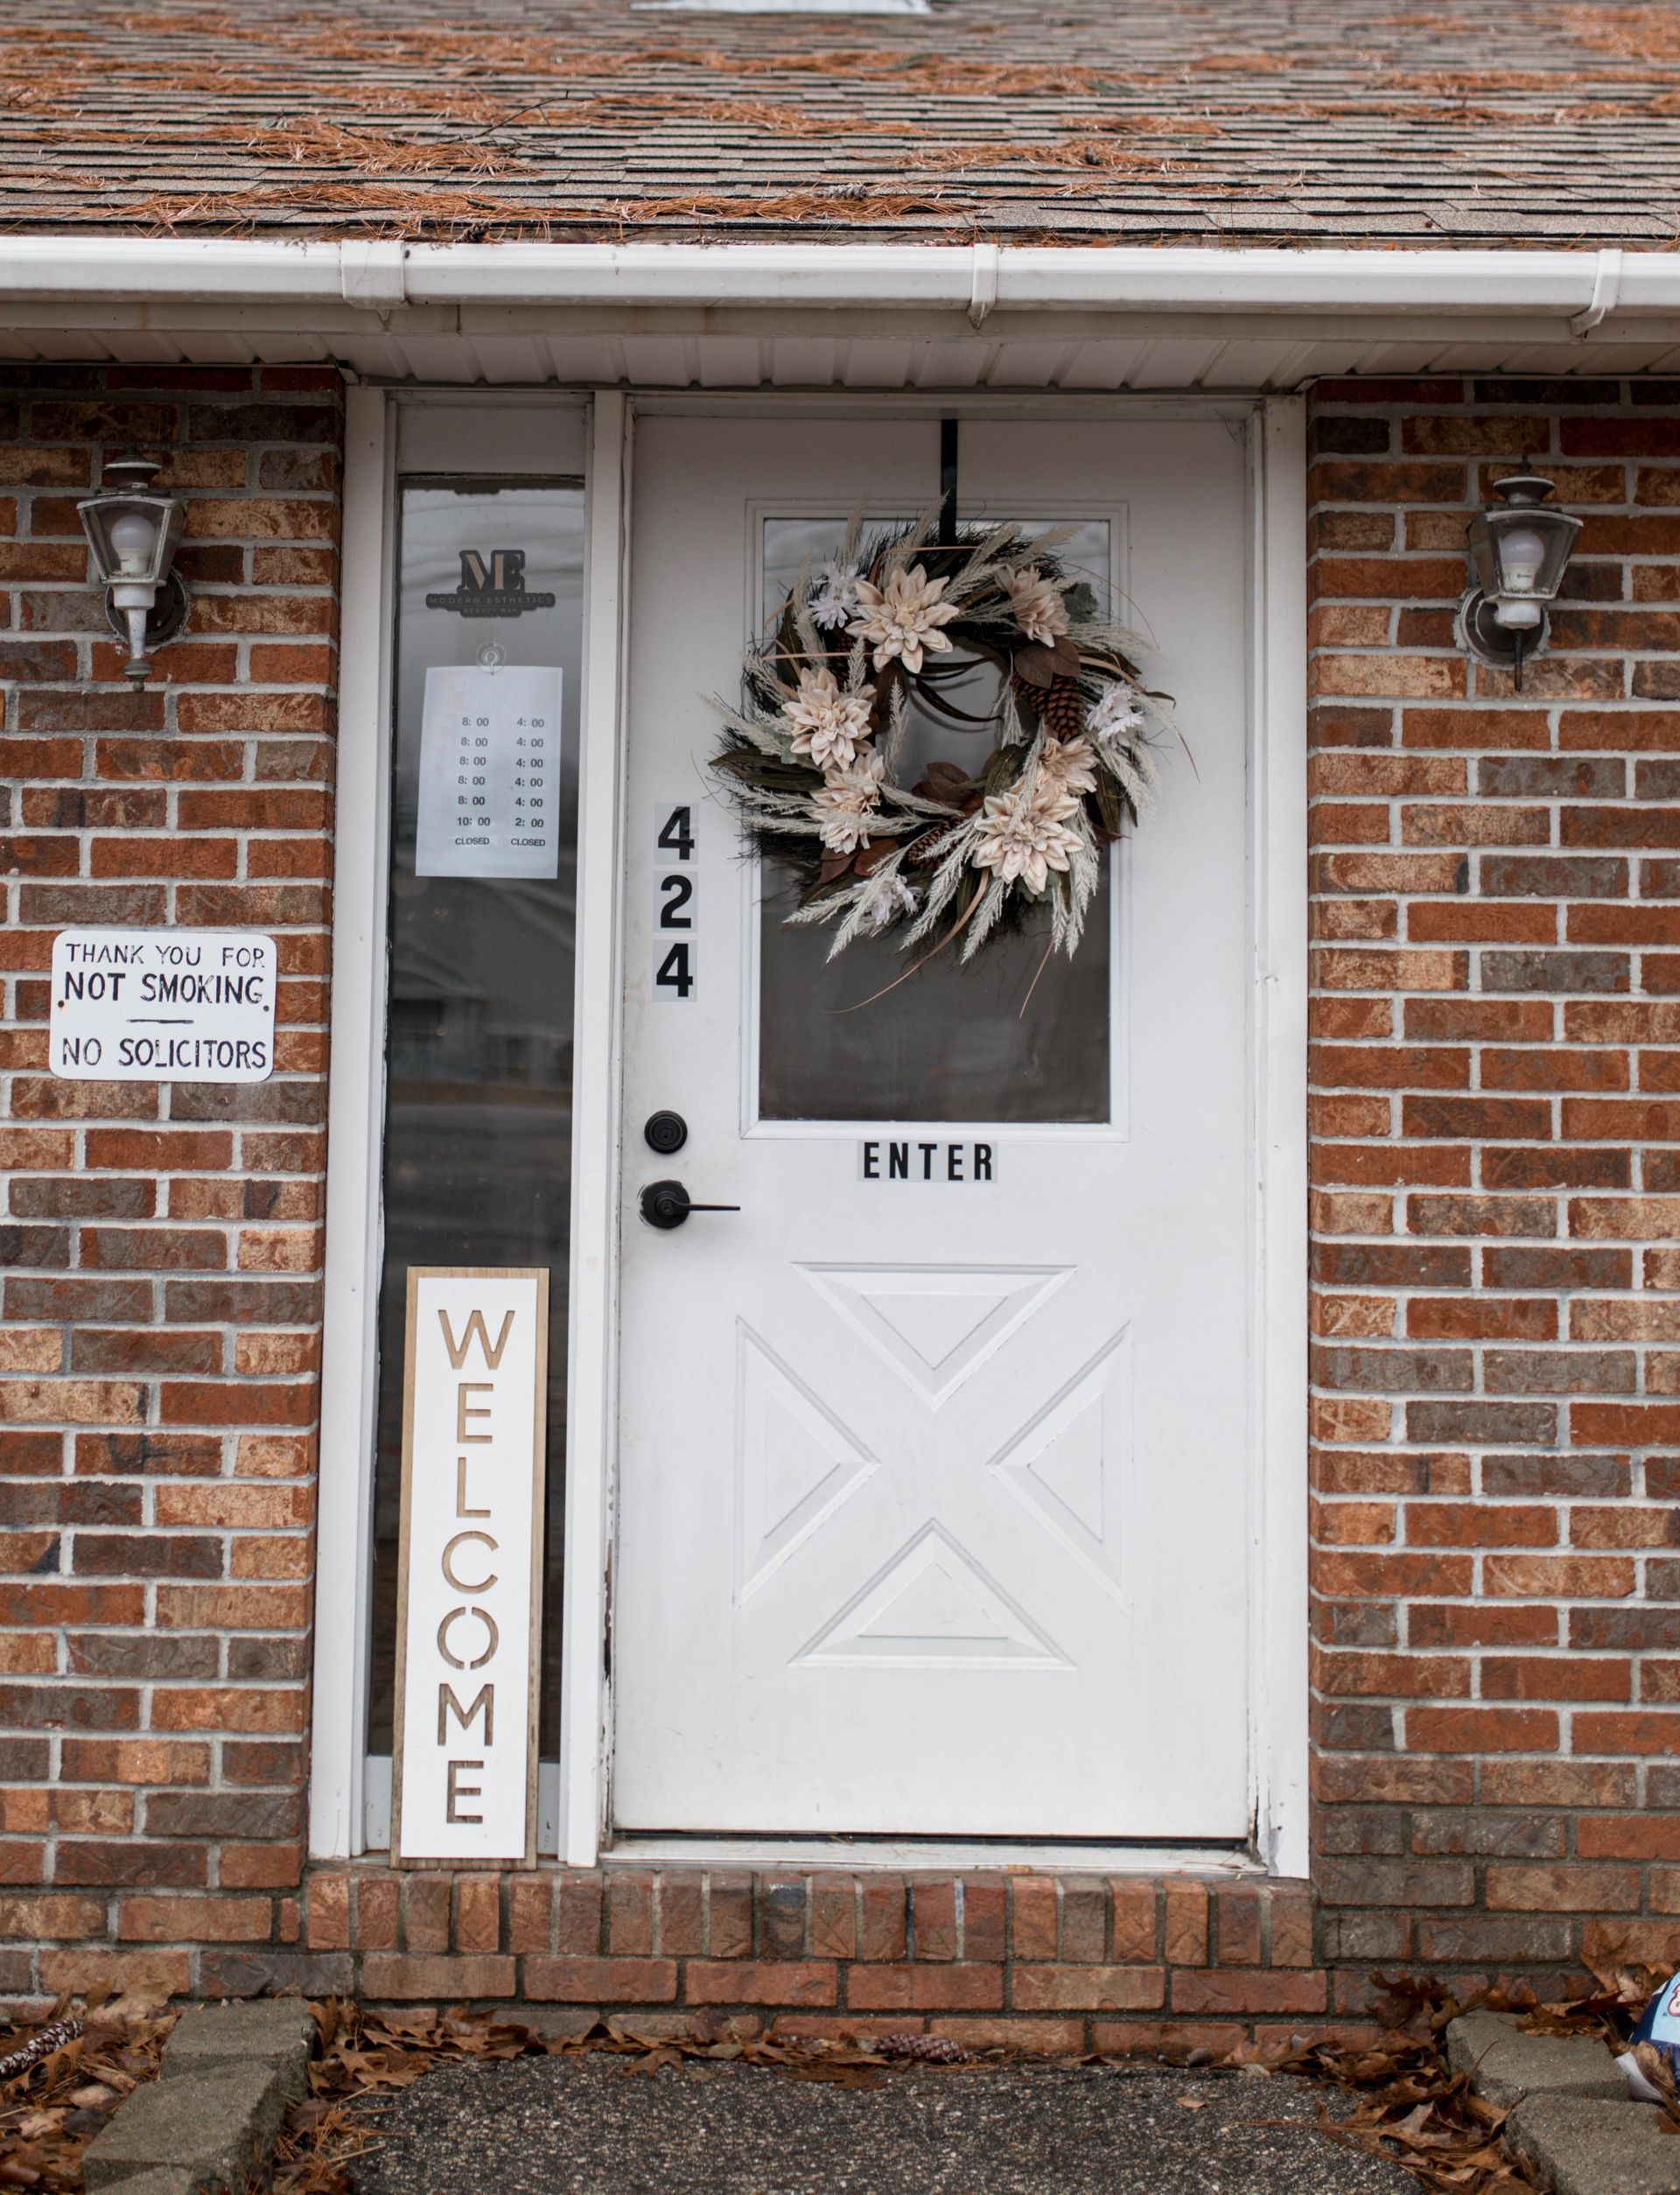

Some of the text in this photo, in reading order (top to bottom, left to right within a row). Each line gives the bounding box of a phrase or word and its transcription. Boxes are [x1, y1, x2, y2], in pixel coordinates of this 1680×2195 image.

[428, 596, 553, 605] MODERN ESTHETICS
[454, 837, 546, 847] CLOSED CLOSED
[65, 943, 265, 968] THANK YOU FOR
[64, 971, 264, 1005] NOT SMOKING
[62, 1037, 267, 1069] NO SOLICITORS
[863, 1141, 992, 1182] ENTER
[436, 1308, 516, 1825] WELCOME
